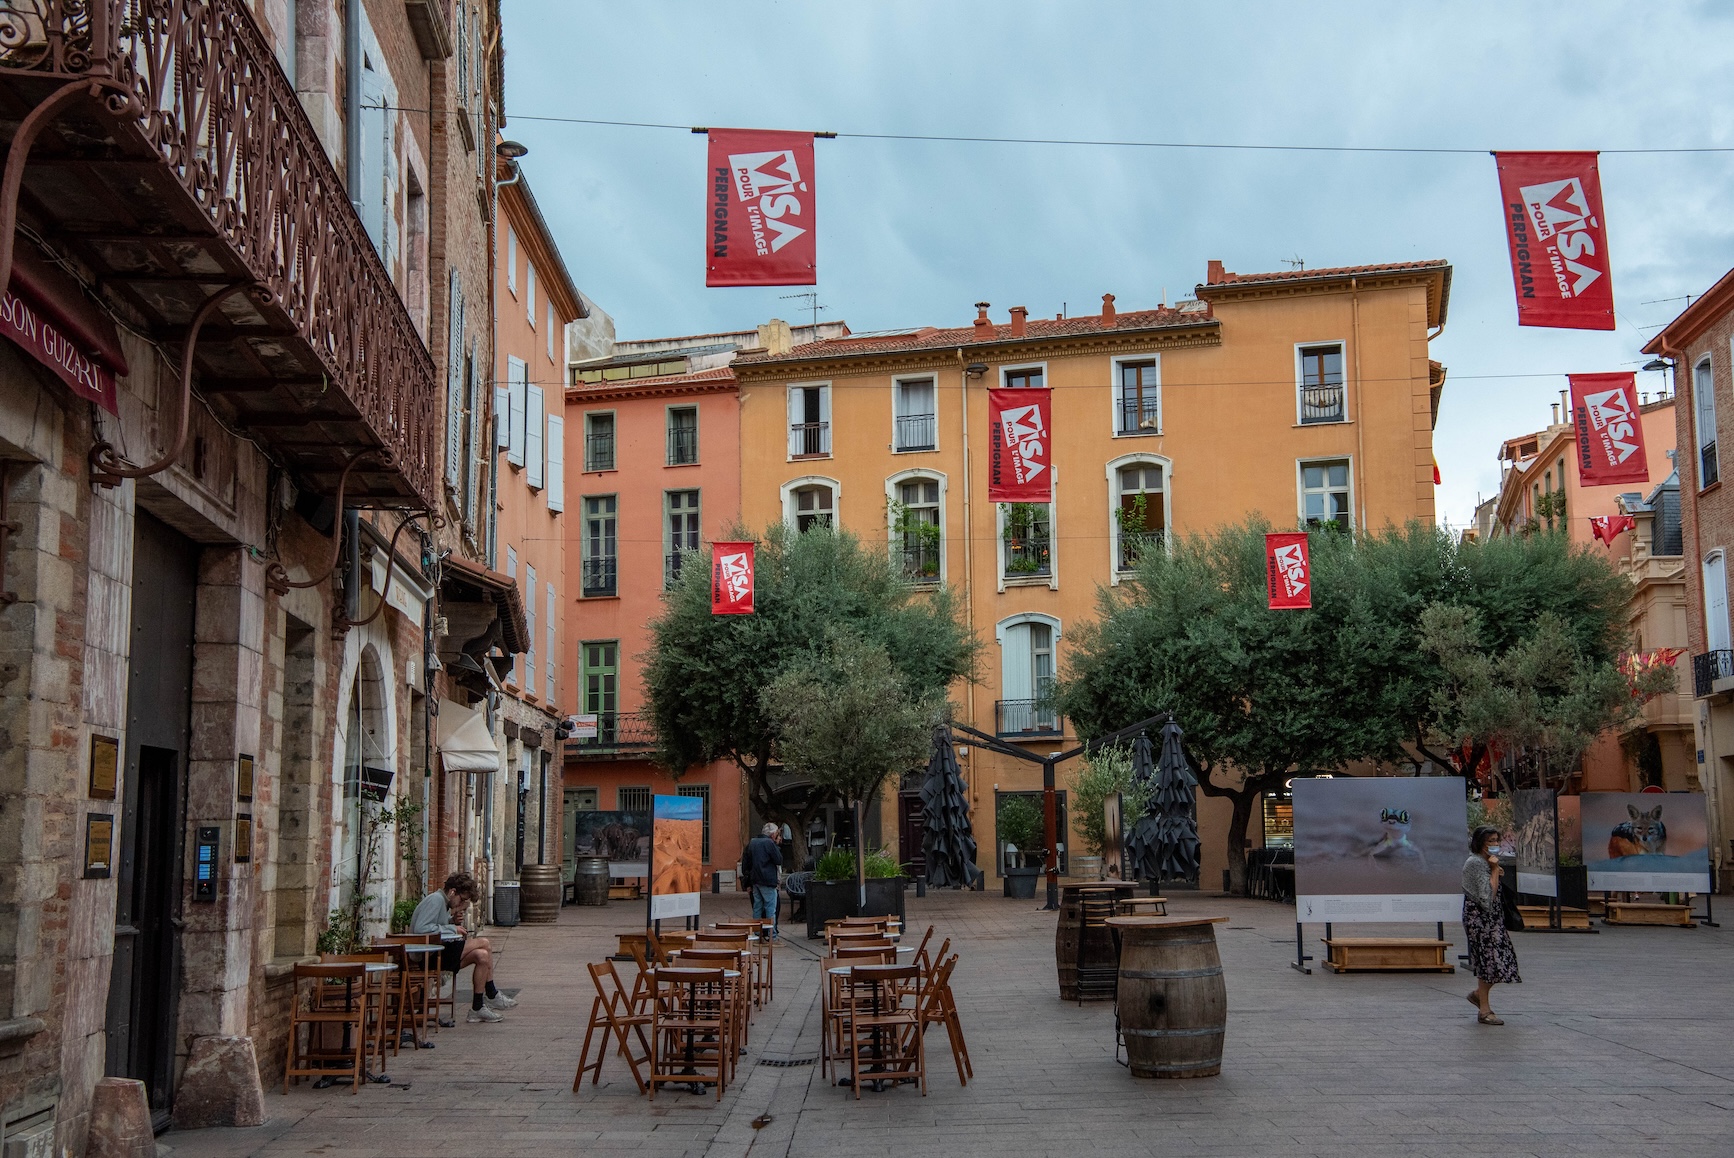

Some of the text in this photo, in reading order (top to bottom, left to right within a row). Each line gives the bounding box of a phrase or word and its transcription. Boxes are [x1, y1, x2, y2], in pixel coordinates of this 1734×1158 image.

[713, 168, 729, 258] PERPIGNAN
[737, 168, 768, 256] POUR L'IMAGE
[1509, 203, 1536, 299] PERPIGNAN
[1530, 202, 1571, 299] POUR L'IMAGE
[992, 422, 1001, 485] PERPIGNAN
[1005, 421, 1025, 485] POUR L'IMAGE
[1576, 406, 1592, 469] PERPIGNAN
[1590, 404, 1618, 467] POUR L'IMAGE
[1269, 556, 1277, 599] PERPIGNAN
